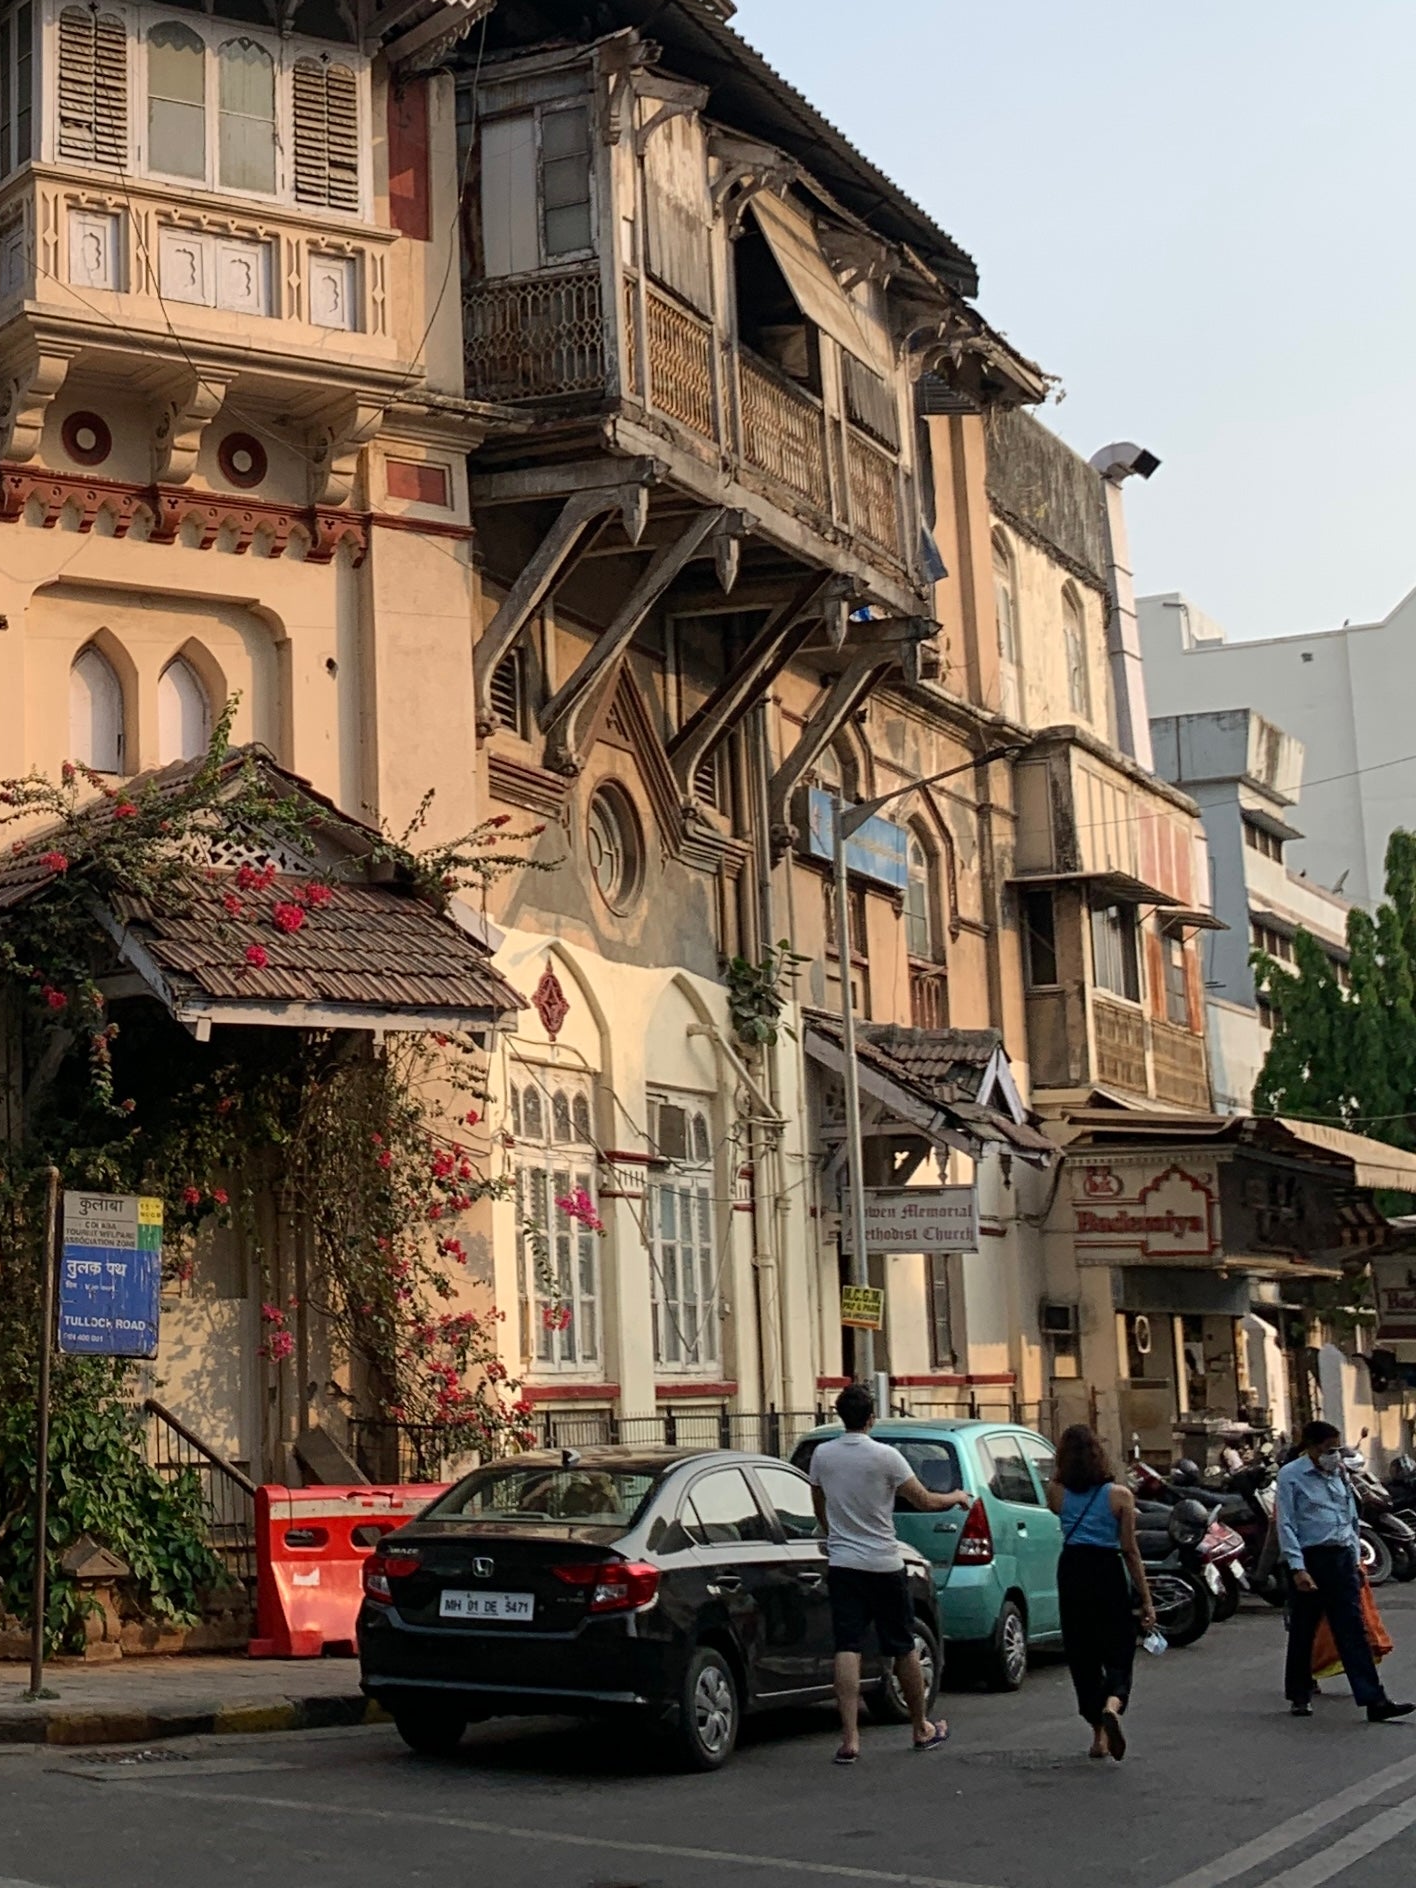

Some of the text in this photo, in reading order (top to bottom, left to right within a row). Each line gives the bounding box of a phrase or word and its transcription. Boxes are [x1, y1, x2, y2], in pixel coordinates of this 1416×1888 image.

[78, 1197, 125, 1216] कुलाबा
[900, 1203, 973, 1219] Memorial
[922, 1226, 974, 1242] Church
[64, 1316, 147, 1331] TULLOCK ROAD
[444, 1599, 529, 1613] MH 01 DE 5471
